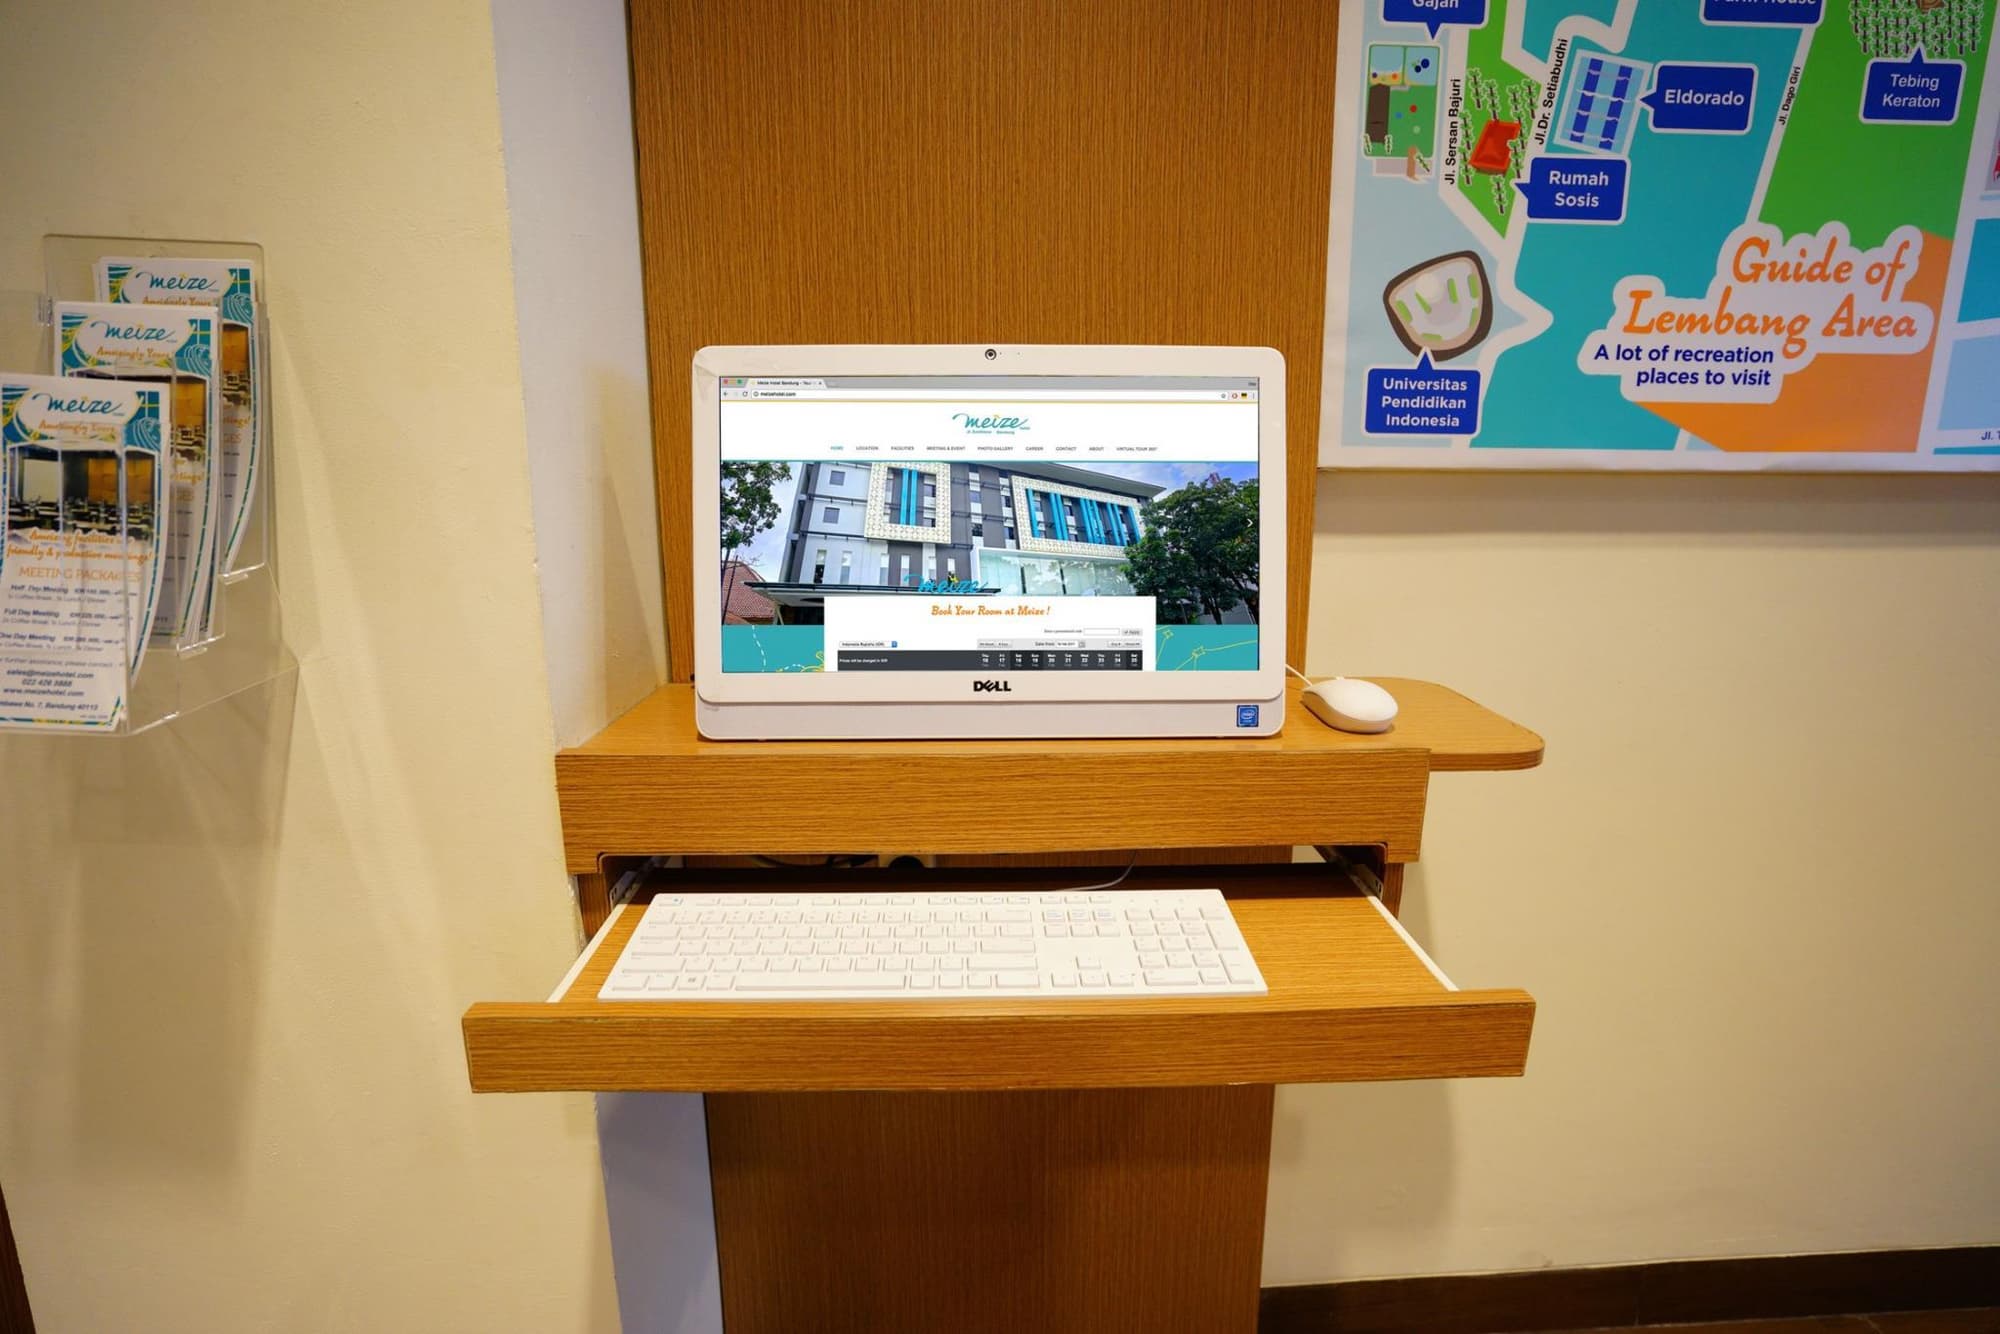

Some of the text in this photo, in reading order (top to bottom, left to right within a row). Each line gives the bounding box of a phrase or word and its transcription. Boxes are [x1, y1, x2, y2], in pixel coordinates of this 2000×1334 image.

[1542, 38, 1568, 110] Setiabudhi
[1890, 73, 1940, 92] Tebing
[1447, 78, 1463, 119] Bajuri
[1664, 88, 1745, 107] Eldorado
[1781, 85, 1796, 113] Dago
[1789, 66, 1801, 85] Giri
[1882, 94, 1941, 109] Keraton
[1445, 123, 1457, 167] Sersan
[1549, 170, 1610, 187] Rumah
[1554, 192, 1600, 208] Sosis
[1732, 235, 1910, 302] Guide of
[135, 271, 217, 290] meize
[89, 321, 176, 341] meize
[1622, 285, 1918, 360] Lembang Area
[1593, 343, 1774, 364] A lot of recreation
[1382, 377, 1468, 392] Universitas
[1635, 368, 1771, 387] places to visit
[32, 392, 122, 414] meize
[1381, 395, 1467, 410] Pendidikan
[952, 412, 1029, 429] meize
[1385, 413, 1461, 428] Indonesia
[55, 549, 101, 560] poductive
[18, 566, 73, 579] MEETING
[32, 610, 60, 618] Meeting
[931, 604, 952, 616] Book
[955, 605, 975, 616] Your
[978, 605, 1001, 616] Room
[1005, 608, 1015, 616] at
[1017, 605, 1044, 616] Meize
[29, 634, 56, 643] Meeting
[973, 680, 1012, 692] DELL
